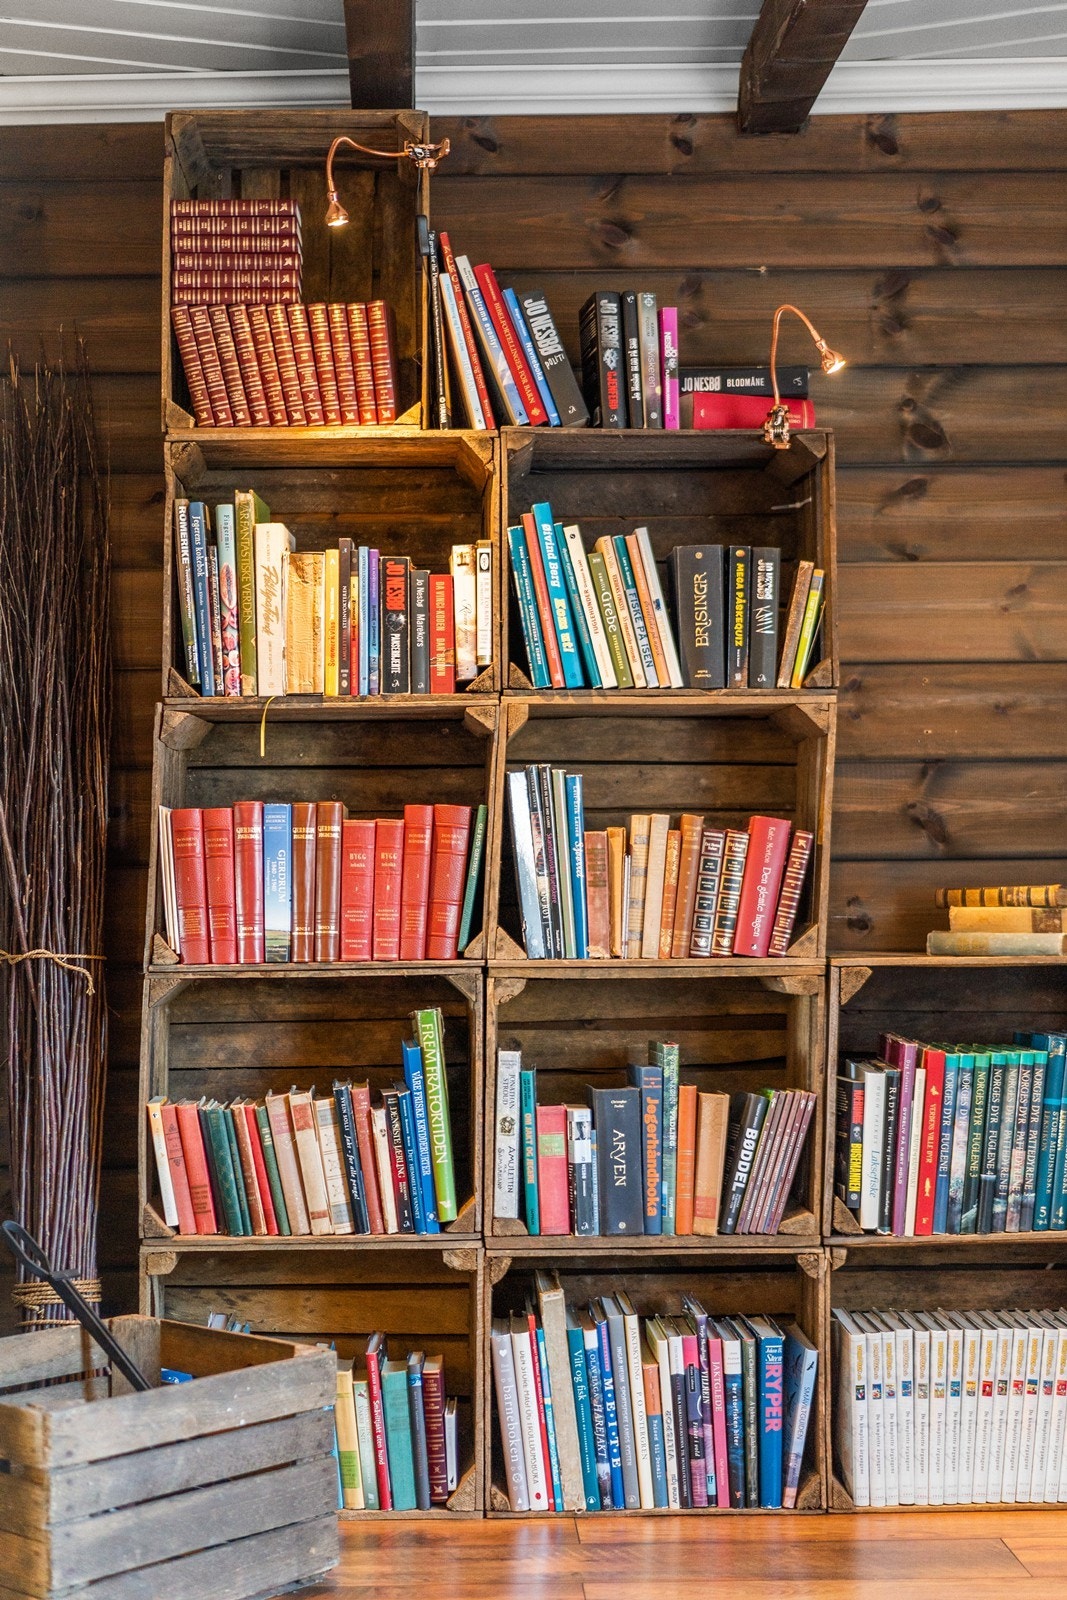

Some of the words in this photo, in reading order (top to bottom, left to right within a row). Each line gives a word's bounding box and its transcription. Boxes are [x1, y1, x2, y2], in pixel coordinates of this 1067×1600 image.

[470, 290, 489, 321] Ekstreme
[482, 323, 499, 349] eventyr
[523, 299, 543, 315] JO
[600, 300, 617, 314] JO
[492, 302, 524, 370] BIBELFORTELLINGER
[530, 315, 563, 356] NESBØ
[600, 315, 619, 348] NESBØ
[525, 342, 544, 381] Navneboka
[648, 343, 656, 388] Hviskeren
[670, 347, 677, 357] JO
[516, 371, 529, 384] FOR
[606, 371, 618, 410] GJENFERD
[682, 378, 693, 392] JO
[694, 376, 721, 392] NESBØ
[726, 377, 765, 387] BLODMÅNE
[521, 384, 536, 404] BARN
[178, 506, 189, 564] ROMERIKE
[192, 516, 201, 546] Jegerens
[195, 547, 204, 577] kokebok
[386, 561, 405, 576] JO
[541, 524, 556, 559] Øivind
[549, 562, 560, 587] Berg
[435, 582, 444, 590] DA
[736, 563, 744, 589] MEGA
[385, 577, 405, 611] NESBØ
[416, 587, 424, 607] Nesbø
[629, 593, 643, 623] FISKE
[435, 591, 445, 631] VINCI-KODEN
[584, 589, 599, 634] FUGLEHUNDER
[694, 572, 711, 648] BRISINGR
[734, 592, 746, 646] PÅSKEQUIZ
[753, 605, 774, 634] KNIV
[416, 614, 425, 647] Marekors
[636, 626, 647, 641] PÅ
[390, 633, 401, 674] PANSERHJERTE
[640, 644, 653, 668] ISEN
[474, 834, 482, 847] RUD:
[767, 827, 776, 840] Kate
[471, 849, 480, 877] GJERDRUM
[546, 832, 556, 873] Skandinaviske
[764, 842, 774, 863] Morton
[277, 850, 286, 902] GJERDRUM
[549, 875, 558, 904] fluefiskere
[761, 867, 772, 884] Den
[756, 886, 768, 912] glemte
[752, 914, 765, 937] hagen
[421, 1024, 437, 1063] FREM
[412, 1071, 424, 1090] VÅRE
[426, 1067, 440, 1094] FRA
[943, 1072, 954, 1105] NORGES
[975, 1072, 985, 1105] NORGES
[991, 1068, 1002, 1103] NORGES
[1006, 1068, 1016, 1103] NORGES
[1020, 1069, 1030, 1104] NORGES
[1032, 1068, 1043, 1103] NORGES
[414, 1091, 426, 1118] FRISKE
[524, 1113, 532, 1124] OM
[928, 1103, 936, 1131] VERDENS
[942, 1108, 951, 1126] DYR
[973, 1108, 982, 1126] DYR
[990, 1106, 999, 1123] DYR
[1004, 1105, 1014, 1123] DYR
[1017, 1106, 1027, 1124] DYR
[1030, 1105, 1040, 1123] DYR
[428, 1095, 447, 1163] FORTIDEN
[524, 1127, 533, 1144] JAKT
[1041, 1110, 1050, 1151] LEKSIKON
[1050, 1111, 1058, 1138] STORE
[416, 1120, 430, 1176] KRYDDERURTER
[526, 1146, 533, 1156] OG
[900, 1136, 907, 1145] PÅ
[927, 1132, 935, 1149] VILLE
[939, 1133, 950, 1172] FUGLENE
[970, 1133, 980, 1171] FUGLENE
[987, 1130, 997, 1169] FUGLENE
[507, 1146, 516, 1193] AMULETTEN
[526, 1159, 534, 1184] JEGERE
[610, 1129, 626, 1187] ARVEN
[644, 1097, 660, 1216] Jegerhåndboka
[732, 1128, 758, 1192] BØDDEL
[849, 1143, 862, 1192] BUSEMANNEN
[999, 1130, 1012, 1190] PATTEDYRENE
[1012, 1131, 1024, 1191] PATTEDYRENE
[1024, 1130, 1038, 1190] PATTEDYRENE
[1046, 1141, 1055, 1195] MEDISINSKE
[868, 1150, 880, 1198] Laksefiske
[1040, 1206, 1047, 1217] 5
[1056, 1207, 1064, 1218] 4
[573, 1350, 583, 1368] Vilt
[589, 1354, 597, 1374] OLAV
[629, 1327, 640, 1380] JAKTSKYTING
[574, 1370, 584, 1382] og
[701, 1371, 710, 1404] VILLREIN
[712, 1361, 722, 1412] JAKTGLEDE
[577, 1385, 588, 1401] fisk
[765, 1365, 782, 1433] RYPER
[372, 1400, 383, 1434] Småviltjakt
[503, 1385, 522, 1462] barneboken
[796, 1386, 811, 1440] SMÅVILTGUIDEN
[375, 1435, 384, 1448] uten
[593, 1403, 608, 1459] HAREJAKT
[664, 1410, 673, 1461] VILTSPOR
[376, 1450, 385, 1465] hund
